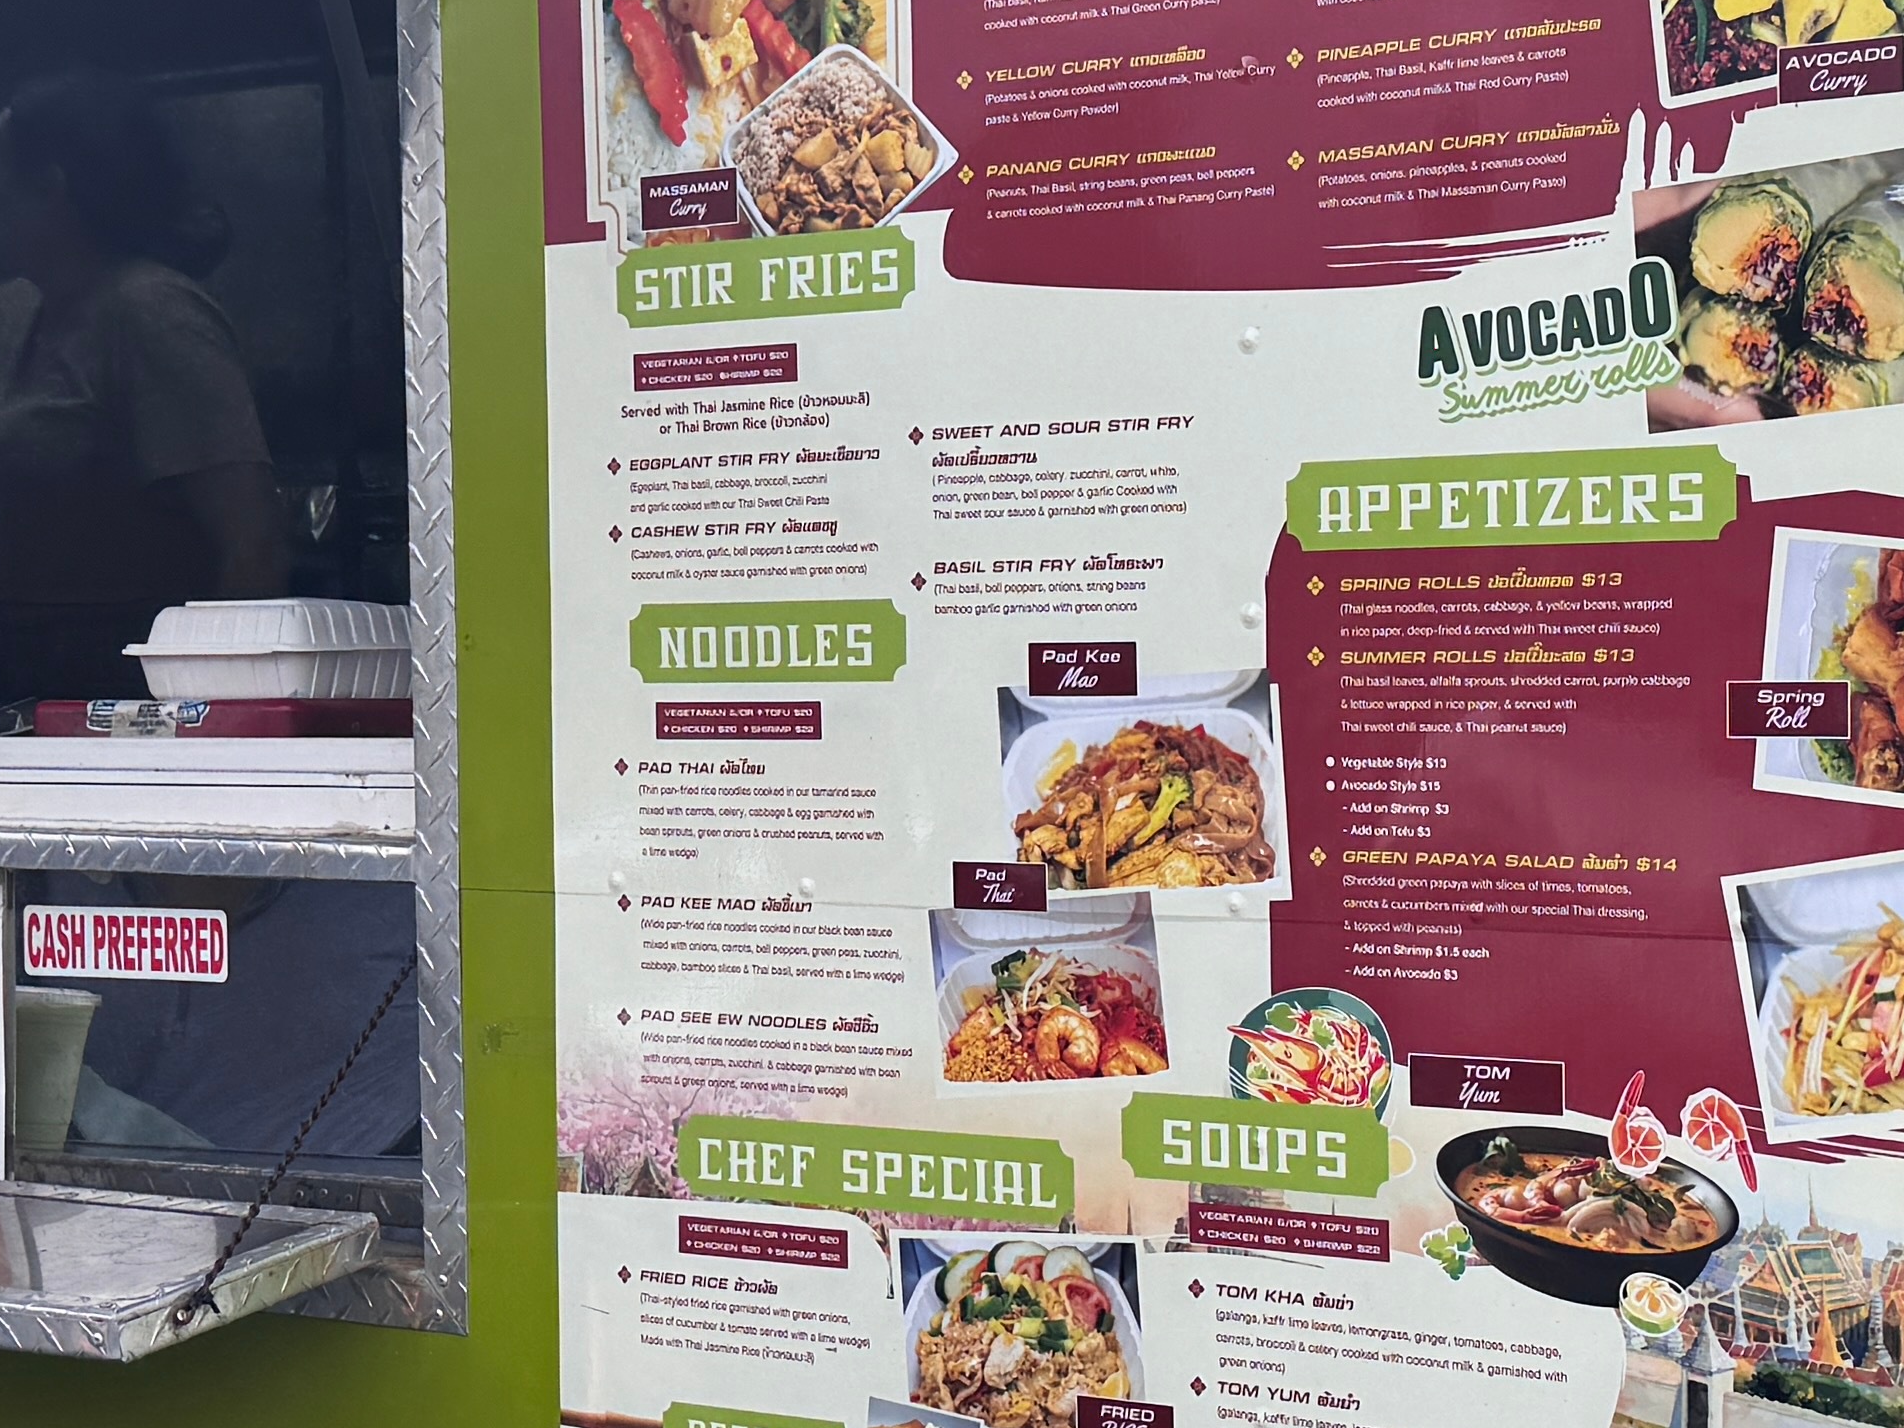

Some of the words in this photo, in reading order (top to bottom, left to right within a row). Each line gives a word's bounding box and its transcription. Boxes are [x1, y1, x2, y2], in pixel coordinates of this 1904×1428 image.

[1785, 44, 1897, 71] AVOCADO
[1808, 68, 1868, 96] Curry
[1318, 139, 1434, 163] MASSAMAN
[1441, 132, 1509, 152] CURRY
[986, 160, 1062, 178] PANANG
[1068, 152, 1130, 170] CURRY
[649, 180, 729, 198] MASSAMAN
[669, 200, 707, 220] Curry
[635, 261, 735, 312] STIR
[761, 248, 899, 302] FRIES
[1440, 368, 1582, 417] Summer
[1589, 343, 1679, 398] rolls
[932, 426, 994, 440] SWEET
[1000, 423, 1040, 437] AND
[1048, 421, 1100, 435] SOUR
[1108, 418, 1149, 432] STIR
[1157, 416, 1195, 430] FRY
[629, 456, 713, 471] EGGPLANT
[718, 454, 752, 467] STIR
[759, 452, 790, 465] FRY
[1318, 473, 1704, 534] APPETIZERS
[934, 561, 985, 574] BASIL
[992, 560, 1032, 573] STIR
[1040, 559, 1076, 571] FRY
[1340, 577, 1411, 591] SPRING
[1418, 576, 1480, 590] ROLLS
[1582, 573, 1623, 589] $13
[659, 623, 873, 669] NOODLES
[1042, 650, 1077, 663] Pad
[1085, 650, 1121, 663] Kee
[1058, 666, 1098, 690] Mao
[1756, 689, 1825, 707] Spring
[1765, 706, 1808, 729] Roll
[638, 762, 672, 774] PAD
[679, 762, 714, 774] THAI
[1350, 802, 1371, 814] Add
[1374, 804, 1388, 814] on
[1391, 802, 1429, 817] Shrimp
[1435, 803, 1449, 815] $3
[1343, 850, 1407, 864] GREEN
[1416, 852, 1497, 868] PAPAYA
[1505, 854, 1575, 869] SALAD
[1636, 857, 1678, 872] $14
[976, 868, 1006, 881] Pad
[641, 896, 674, 909] PAD
[680, 897, 712, 910] KEE
[718, 898, 756, 911] MAO
[983, 884, 1015, 904] Thai
[28, 913, 86, 969] CASH
[93, 915, 224, 974] PREFERRED
[1463, 1065, 1510, 1080] TOM
[1459, 1081, 1501, 1106] Yum
[1163, 1118, 1347, 1179] SOUPS
[697, 1138, 815, 1188] CHEF
[842, 1148, 1057, 1209] SPECIAL
[640, 1270, 686, 1285] FRIED
[692, 1275, 728, 1291] RICE
[1216, 1284, 1257, 1300] TOM
[1264, 1289, 1305, 1306] KHA
[1100, 1405, 1155, 1422] FRIED
